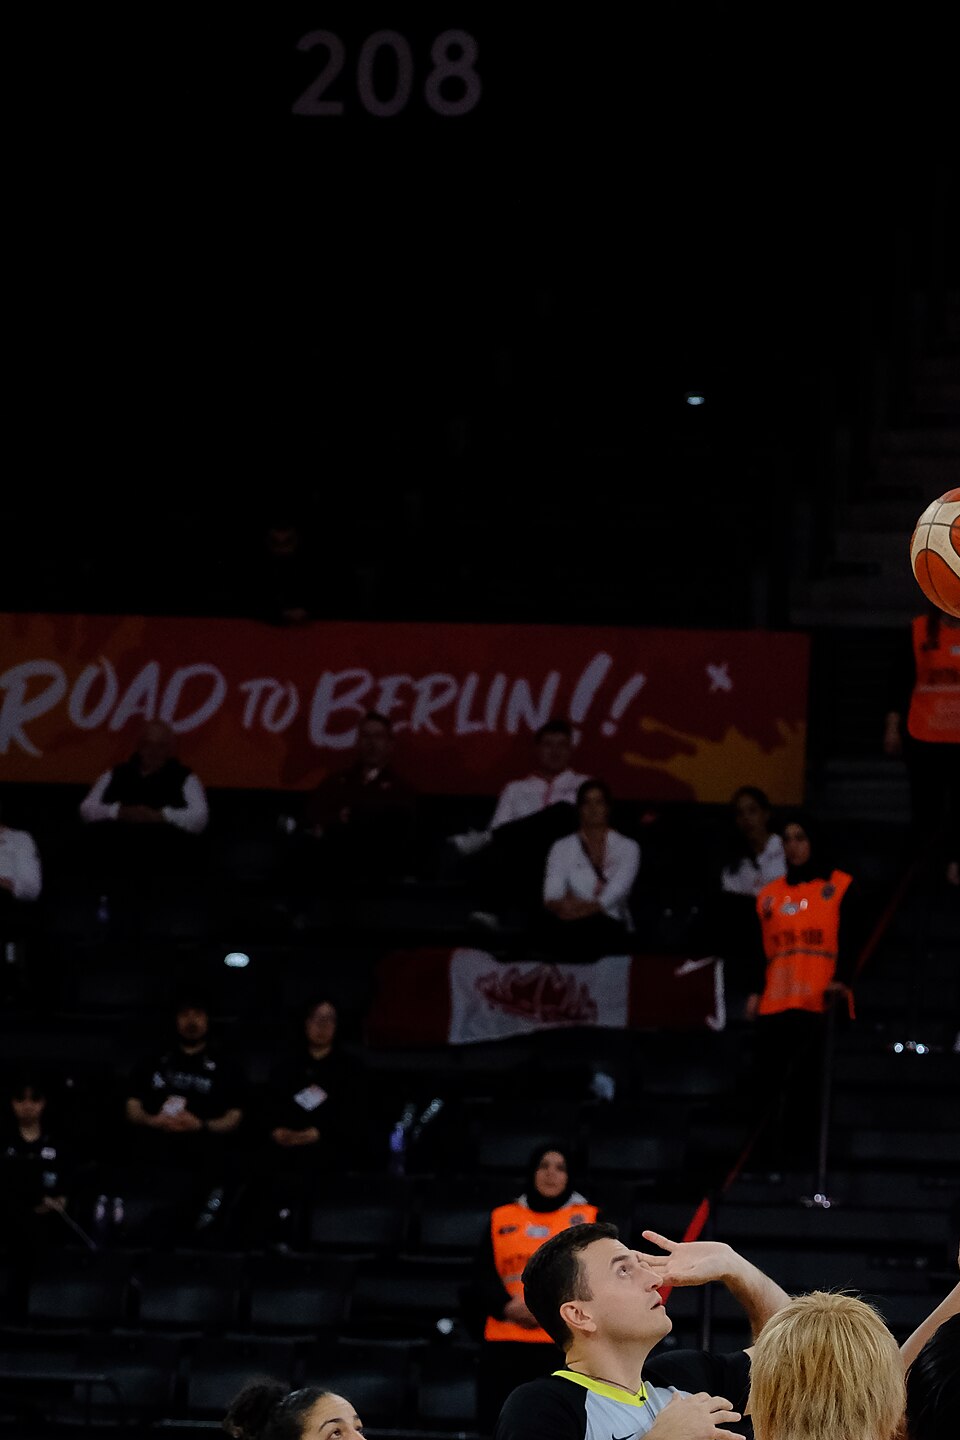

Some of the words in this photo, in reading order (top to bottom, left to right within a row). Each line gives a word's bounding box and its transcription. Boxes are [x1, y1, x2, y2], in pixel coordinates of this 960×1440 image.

[290, 28, 482, 117] 208
[0, 657, 228, 757] ROAD
[238, 676, 300, 733] TO
